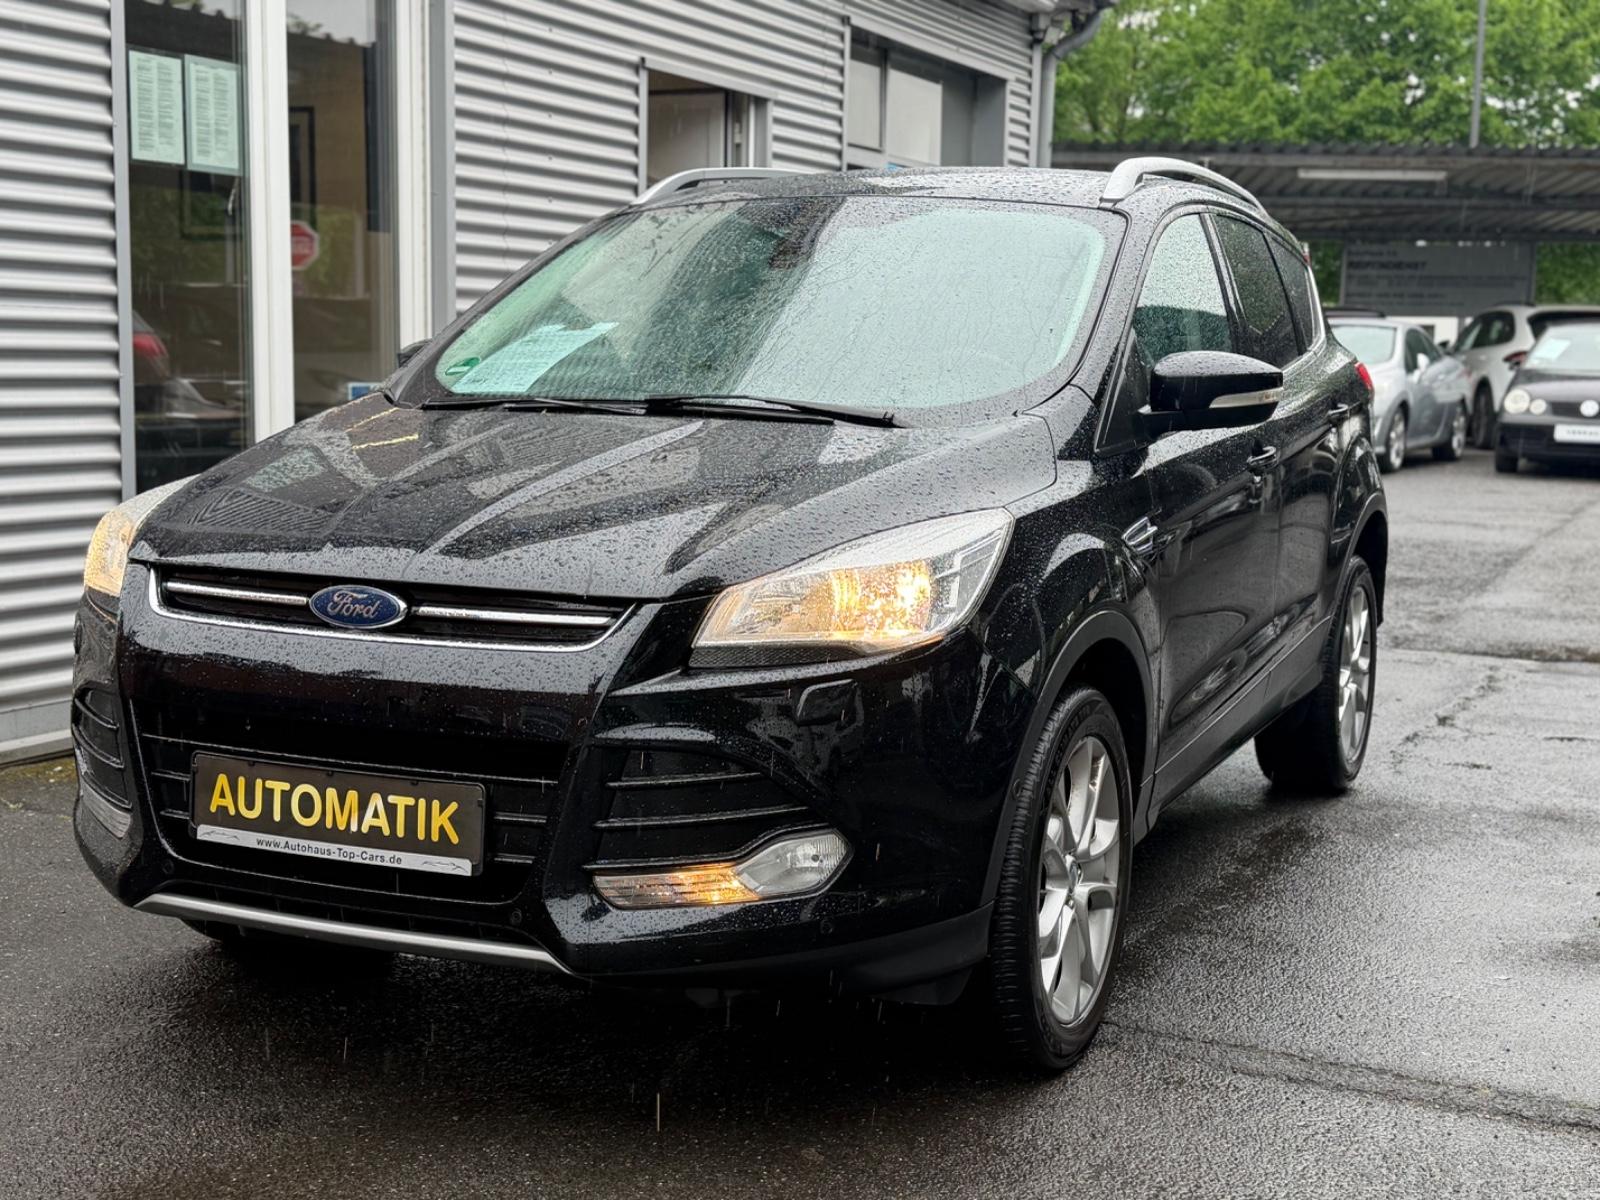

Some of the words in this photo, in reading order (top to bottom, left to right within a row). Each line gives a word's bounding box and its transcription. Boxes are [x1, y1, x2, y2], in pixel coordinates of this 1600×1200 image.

[327, 588, 381, 619] Ford
[209, 773, 459, 845] AUTOMATIK
[255, 837, 403, 865] www.Autohaus-Top-Cars.de
